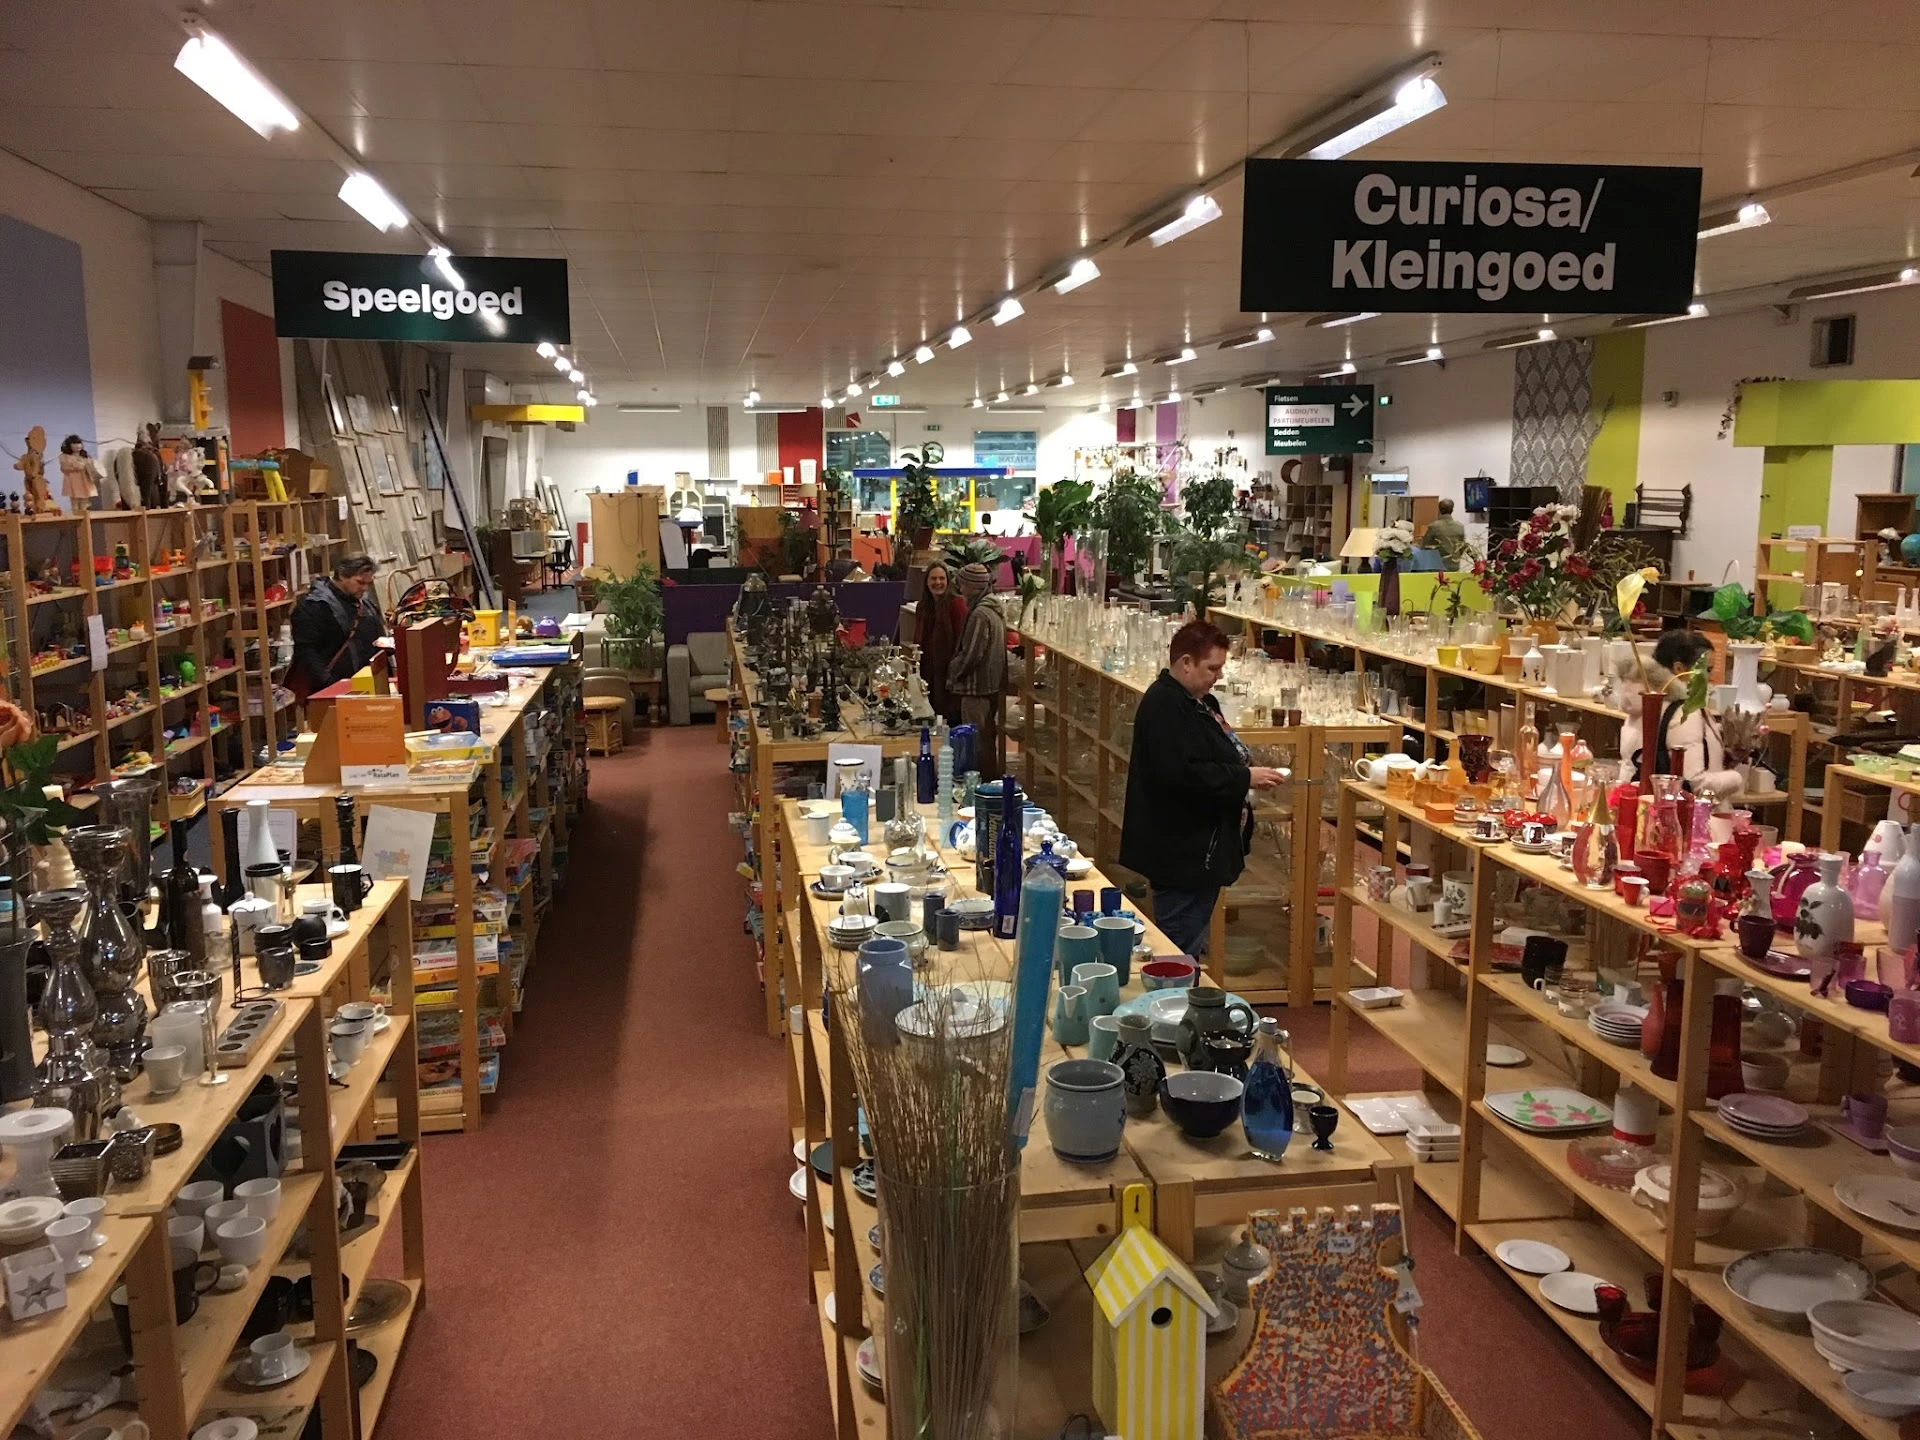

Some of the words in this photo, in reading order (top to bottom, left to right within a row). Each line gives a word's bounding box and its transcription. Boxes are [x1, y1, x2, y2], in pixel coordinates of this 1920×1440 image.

[1353, 173, 1606, 233] Curiosa/
[1331, 238, 1617, 301] Kleingoed
[322, 280, 523, 320] Speelgoed
